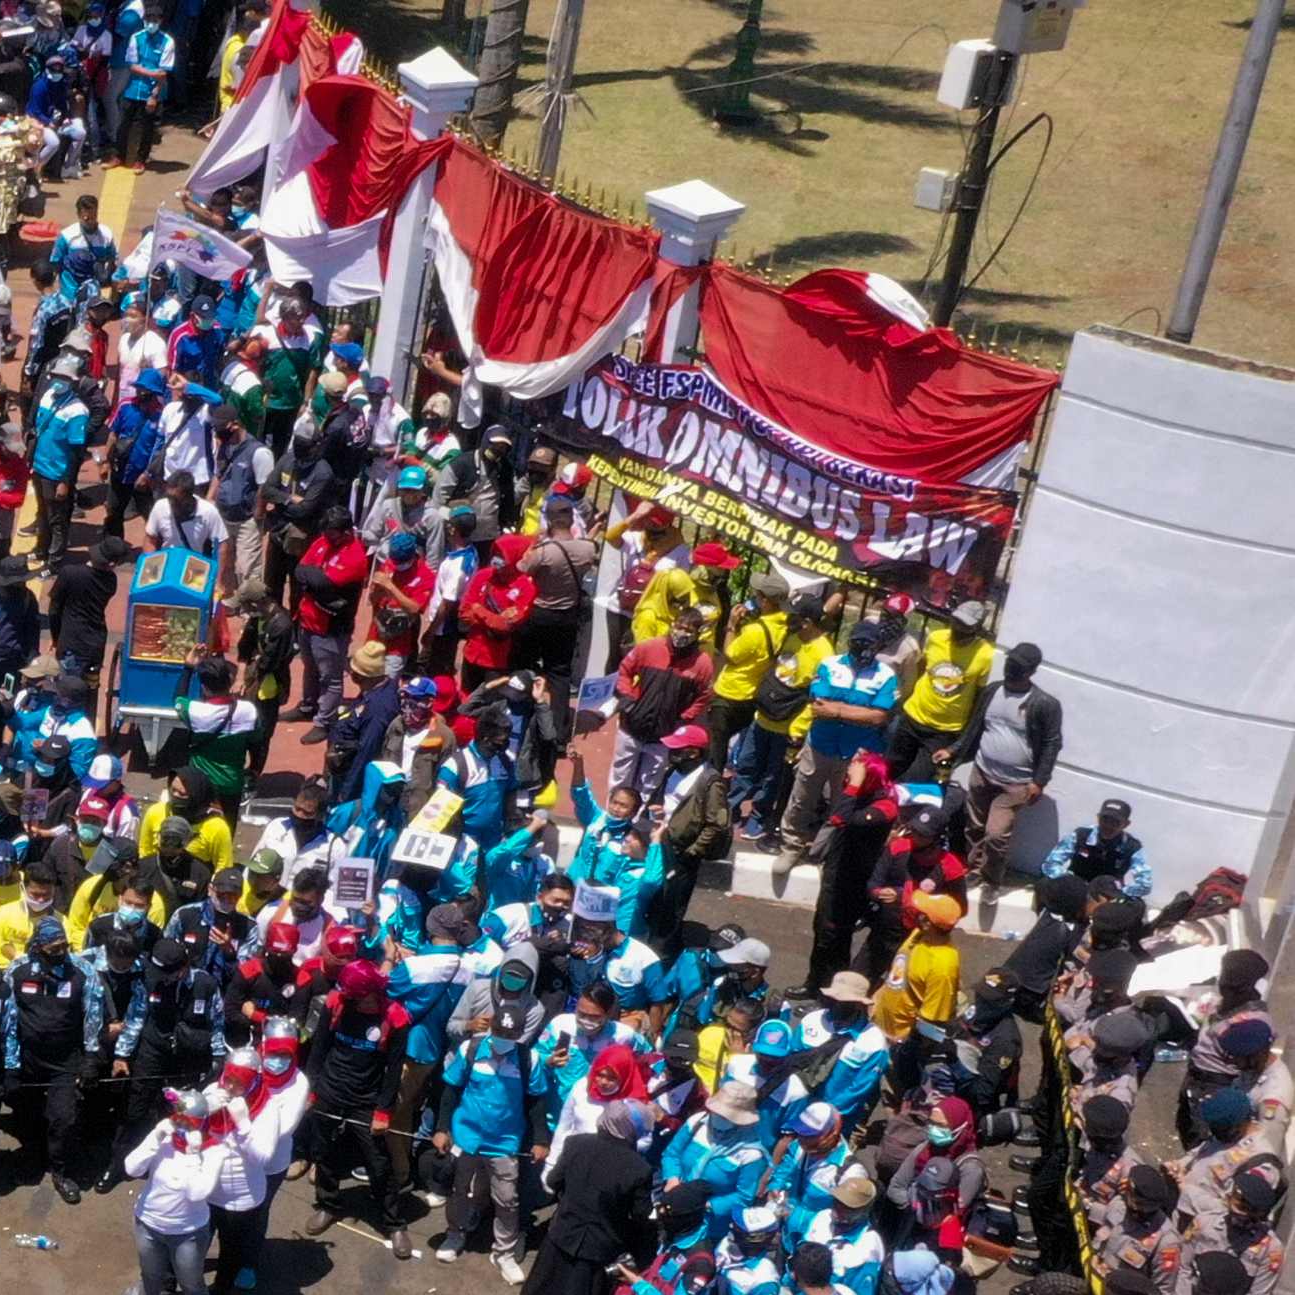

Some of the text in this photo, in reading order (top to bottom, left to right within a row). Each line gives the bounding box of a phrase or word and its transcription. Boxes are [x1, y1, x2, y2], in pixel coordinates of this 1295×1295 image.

[659, 492, 751, 542] INVESTOR
[665, 410, 862, 542] OMNIBUS
[867, 500, 978, 576] LAW
[793, 531, 839, 562] PADA
